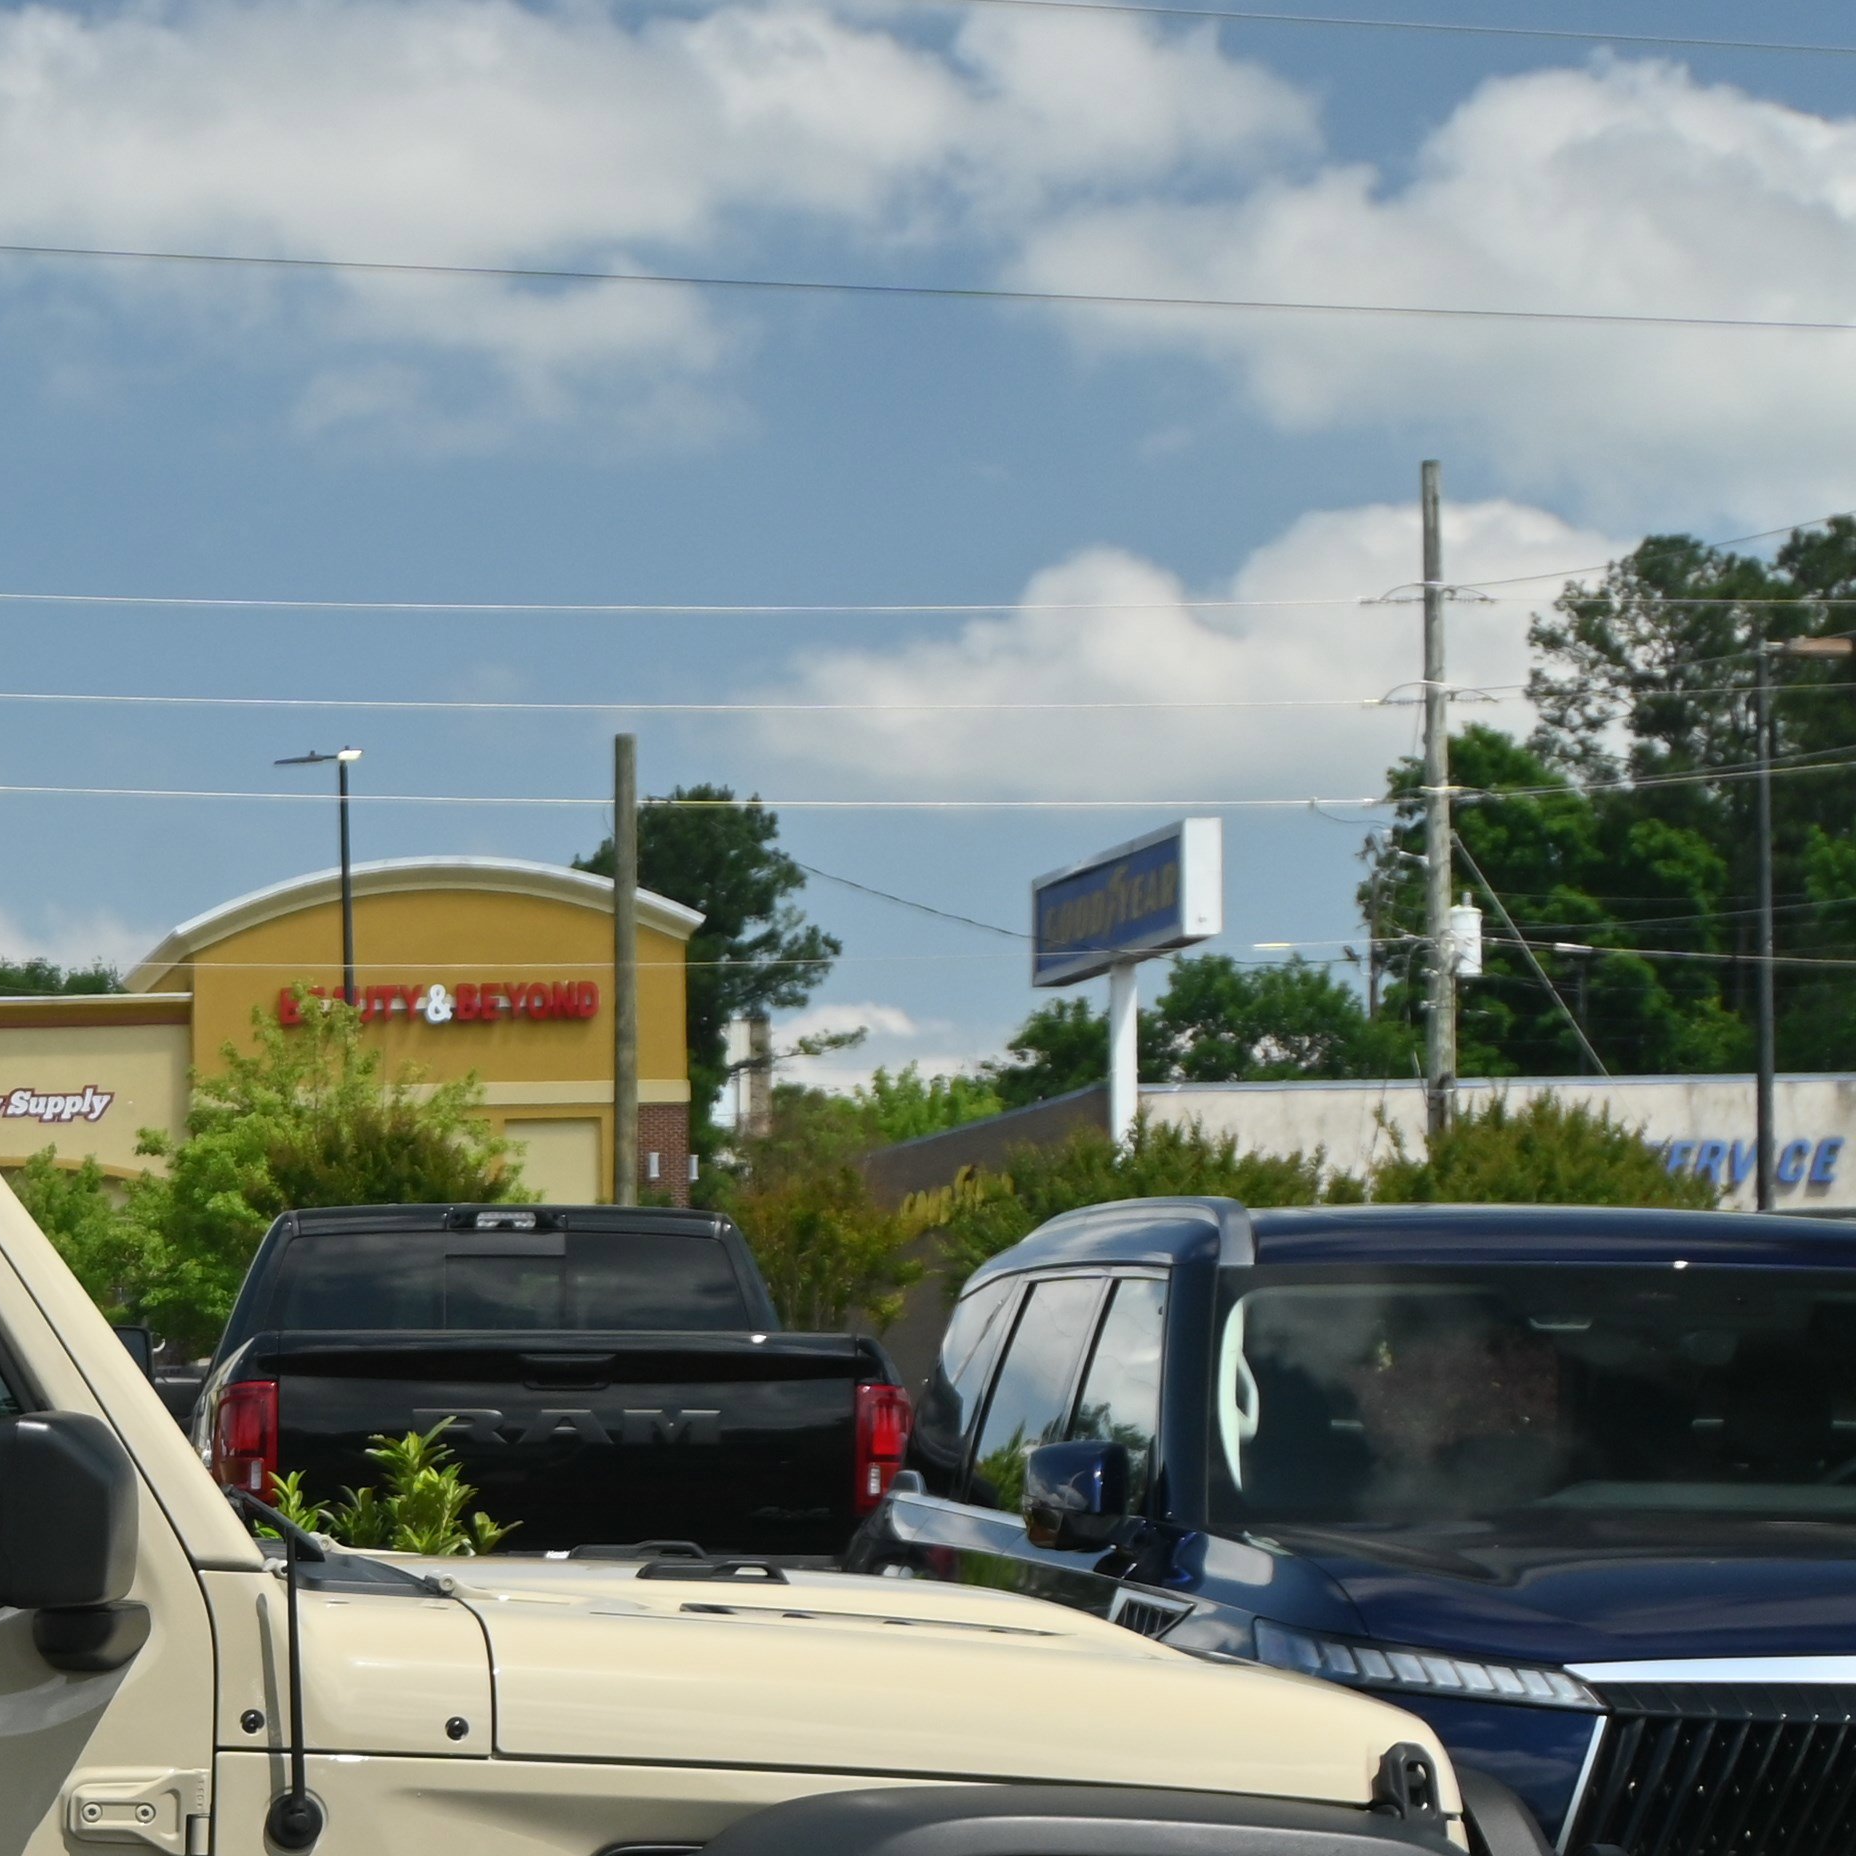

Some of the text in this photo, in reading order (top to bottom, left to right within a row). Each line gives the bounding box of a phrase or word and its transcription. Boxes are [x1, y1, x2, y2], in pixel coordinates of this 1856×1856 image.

[426, 984, 453, 1023] &
[455, 980, 600, 1021] BEYOND
[5, 1086, 113, 1121] Supply
[413, 1408, 721, 1444] RAM
